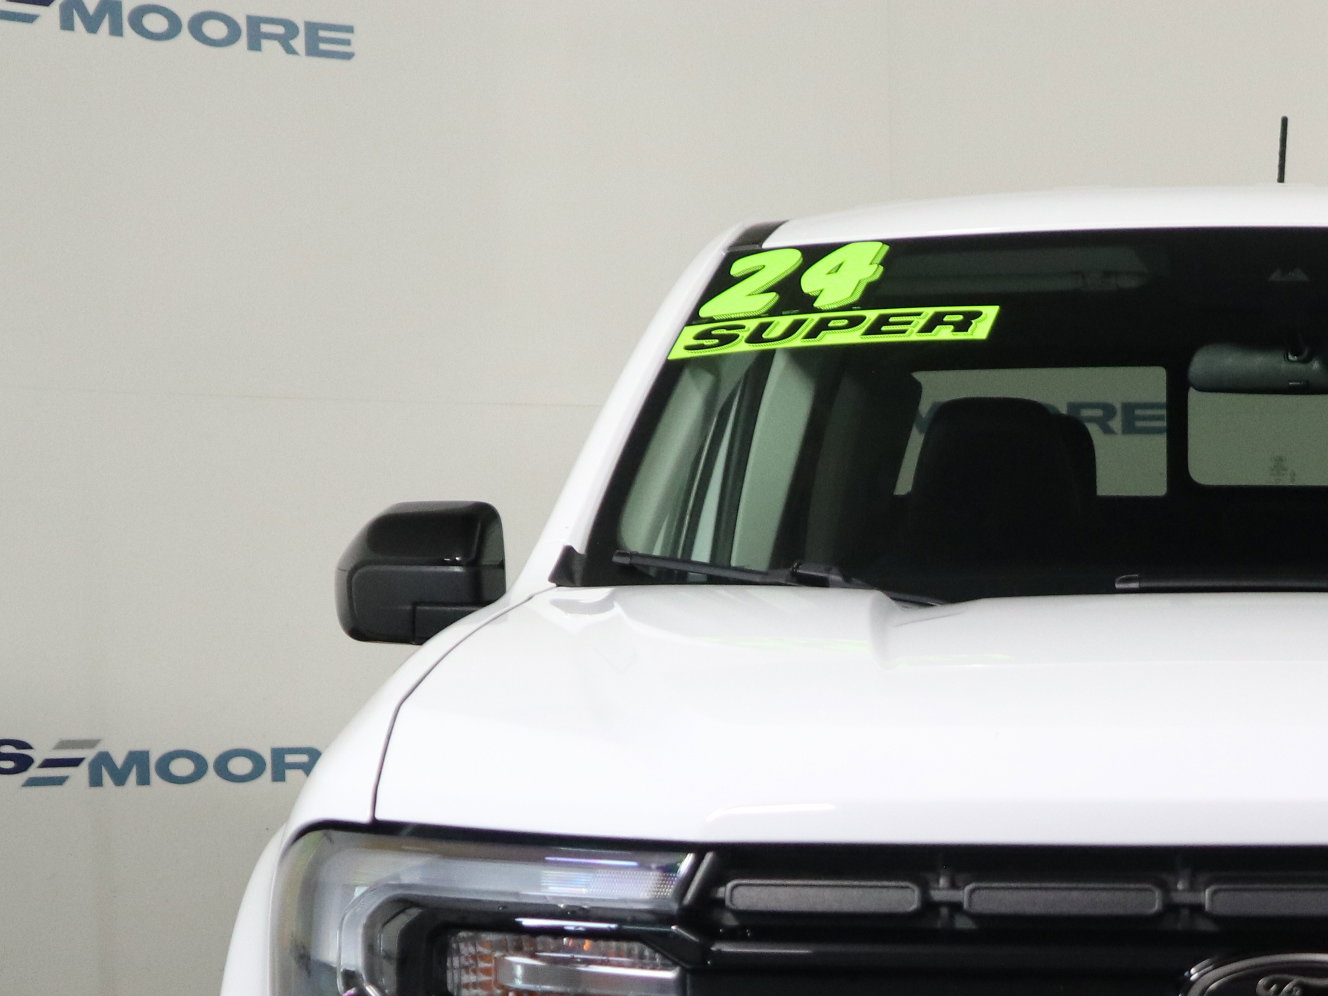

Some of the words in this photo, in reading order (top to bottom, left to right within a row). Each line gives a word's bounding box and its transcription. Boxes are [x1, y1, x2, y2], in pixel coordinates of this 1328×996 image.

[59, 0, 355, 61] MOORE
[698, 241, 890, 320] 24
[683, 310, 987, 354] SUPER
